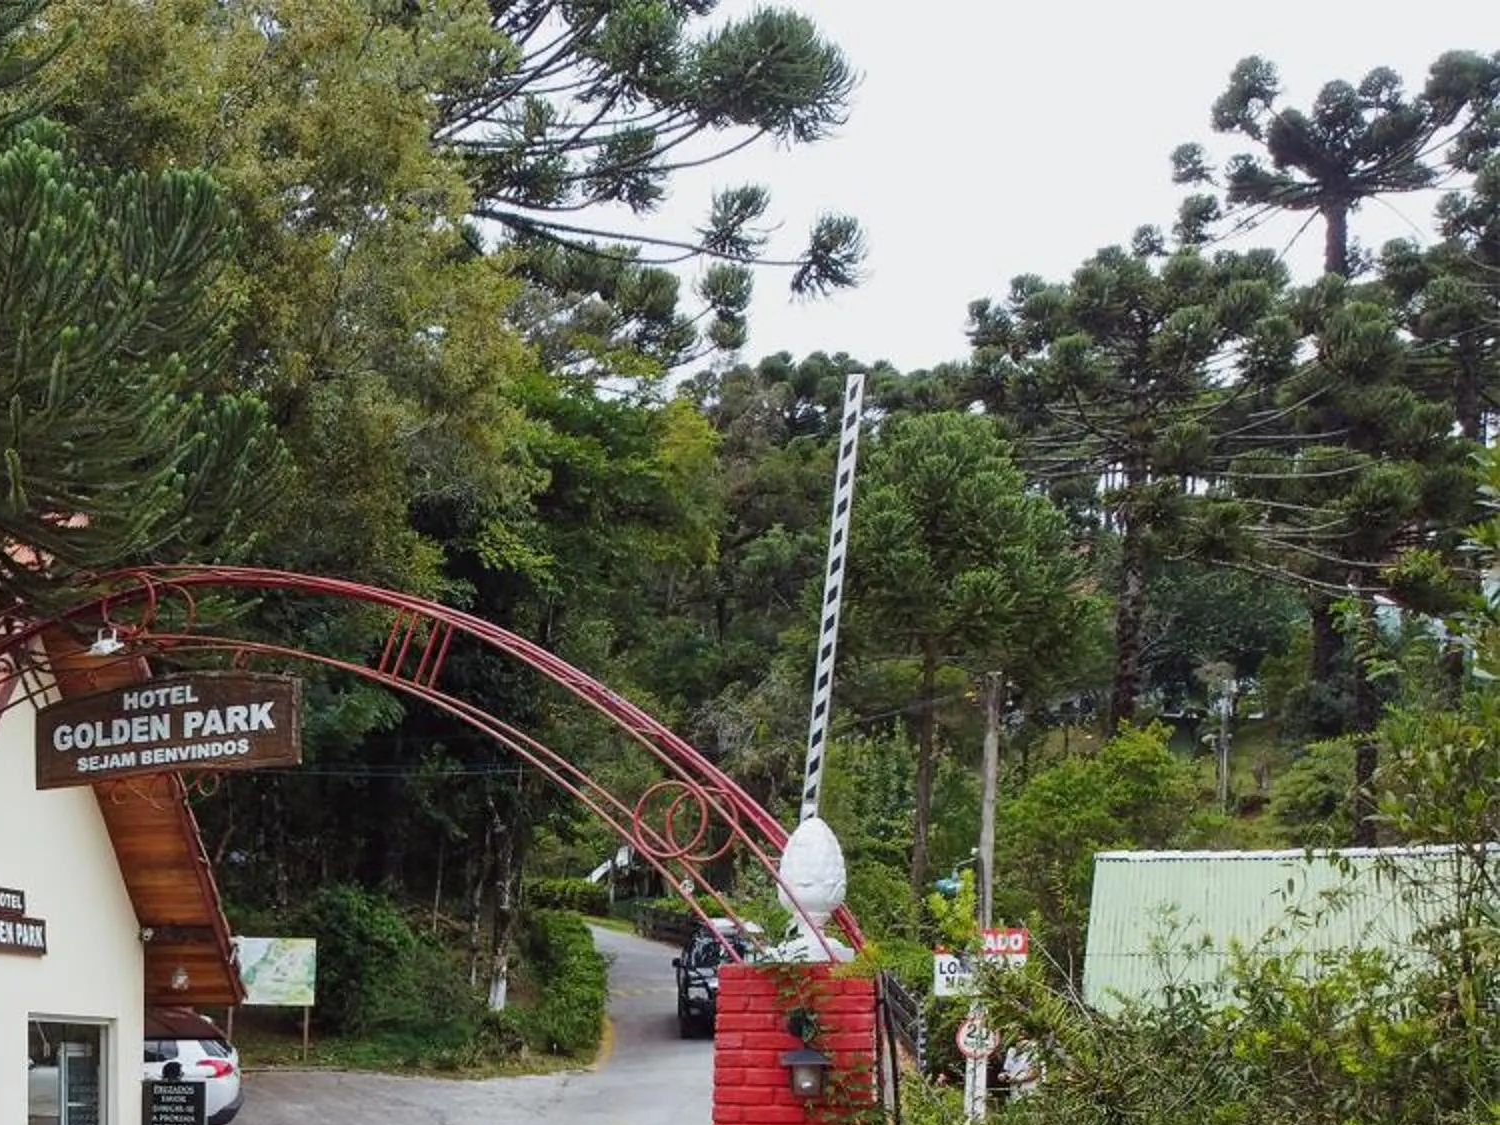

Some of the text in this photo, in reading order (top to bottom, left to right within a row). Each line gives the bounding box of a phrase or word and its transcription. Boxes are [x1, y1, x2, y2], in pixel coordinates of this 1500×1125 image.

[123, 684, 199, 710] HOTEL
[53, 702, 276, 751] GOLDEN PARK
[77, 738, 250, 772] SEJAM BENVINDOS
[16, 923, 44, 947] PARK
